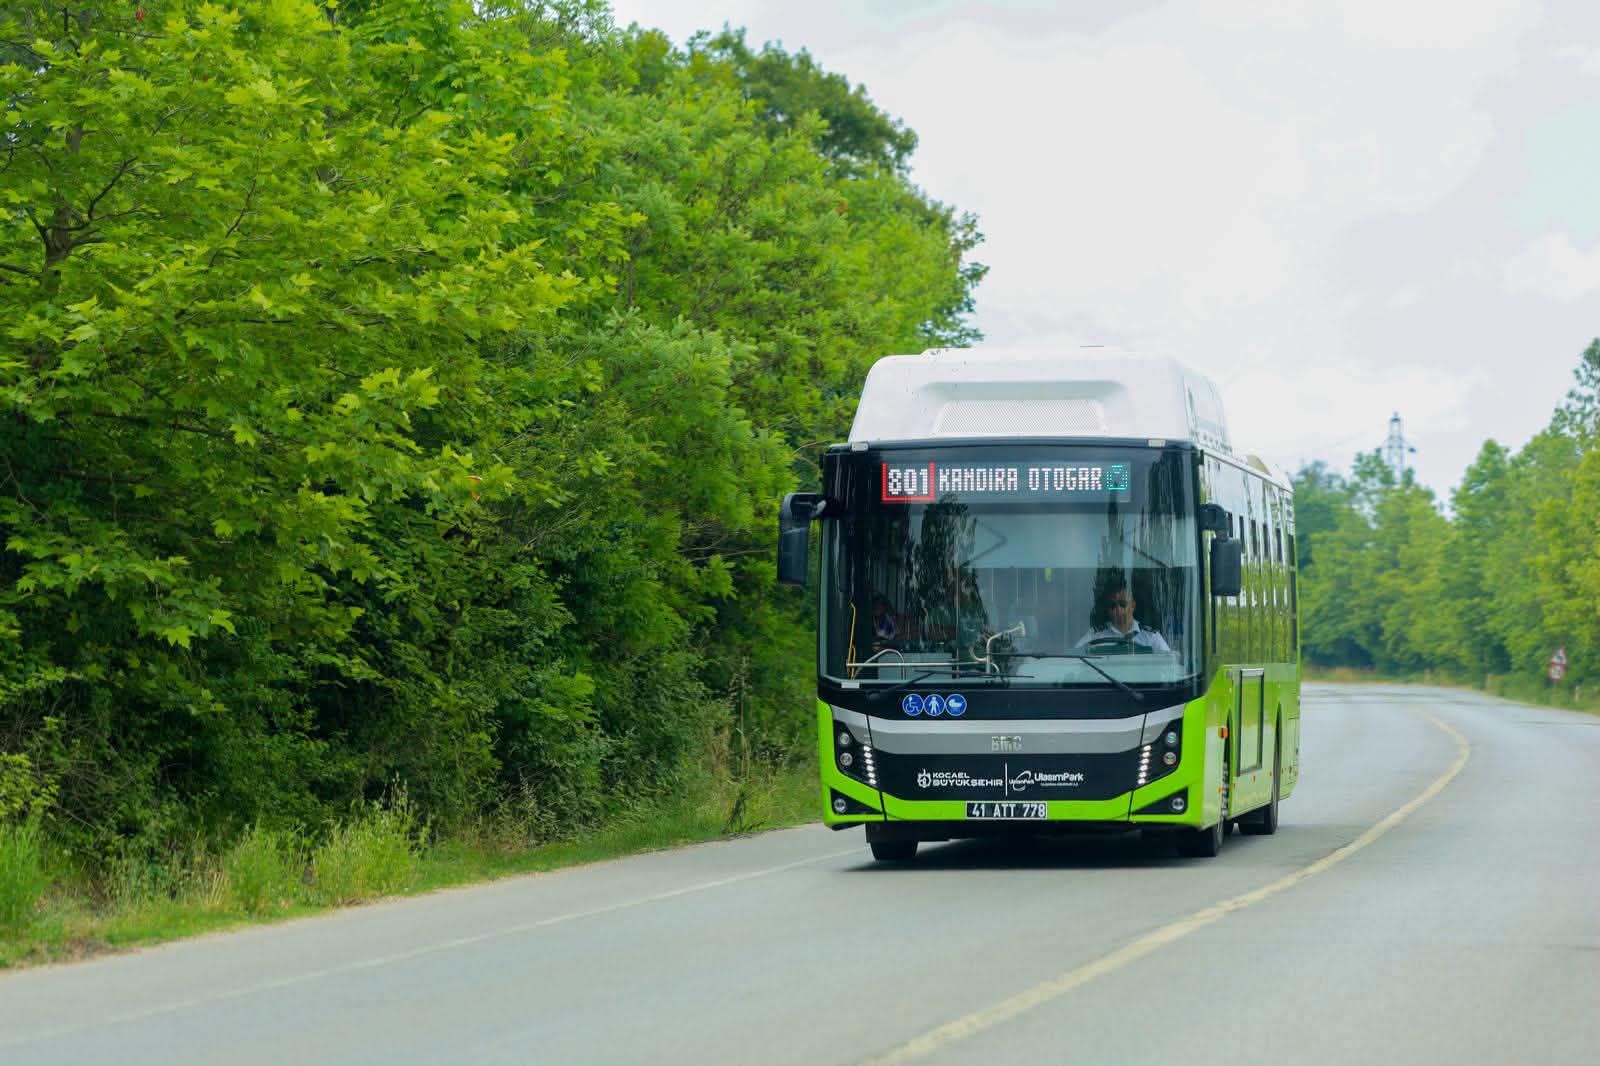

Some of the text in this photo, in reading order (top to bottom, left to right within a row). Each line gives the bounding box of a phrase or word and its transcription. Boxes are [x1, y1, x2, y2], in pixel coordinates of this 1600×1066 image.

[888, 468, 1102, 495] 801 KANDIRA OTOGAR
[991, 736, 1022, 751] BMC
[972, 804, 1045, 817] 41 ATT 778
